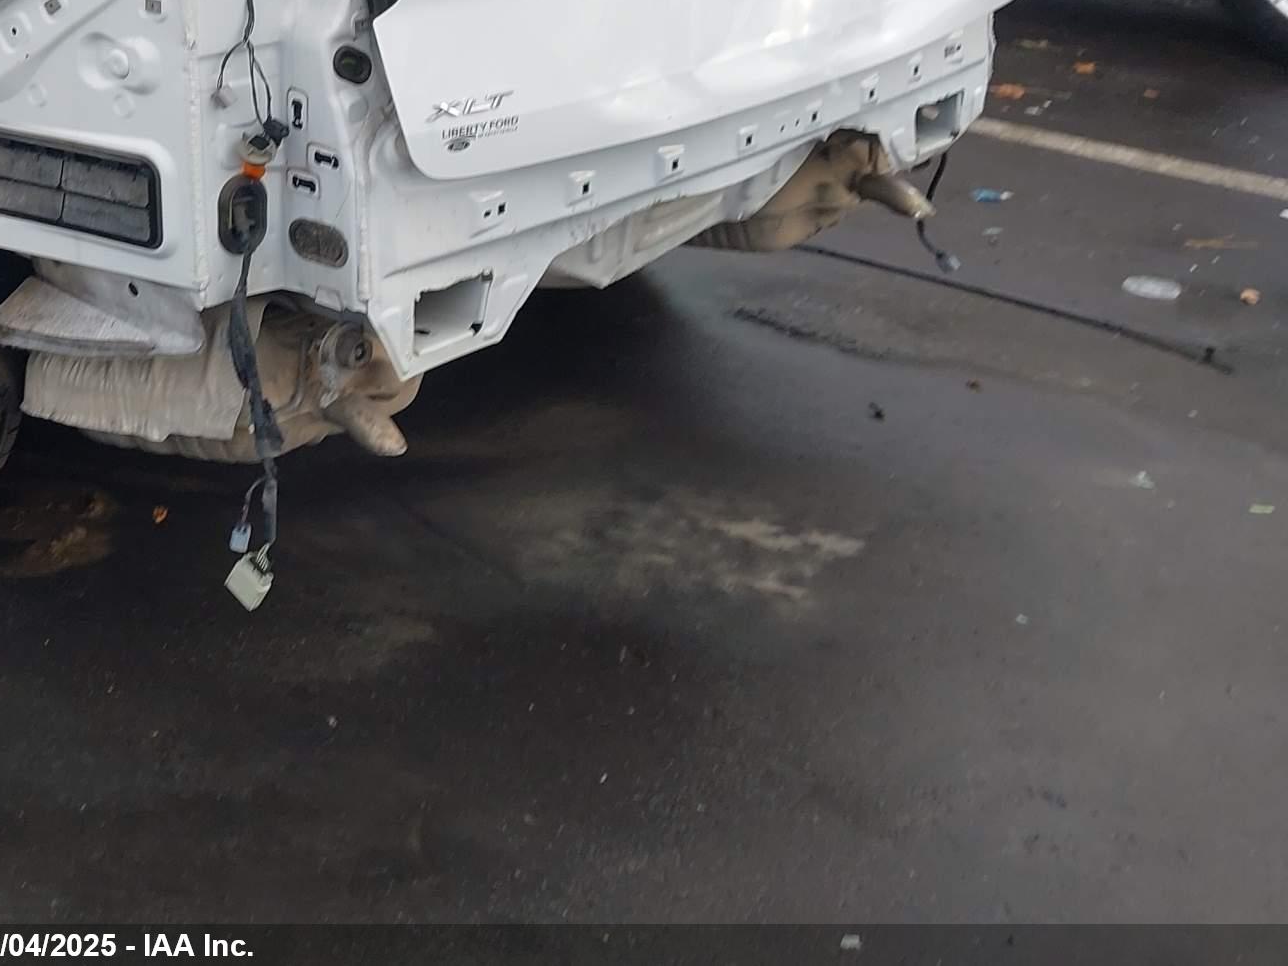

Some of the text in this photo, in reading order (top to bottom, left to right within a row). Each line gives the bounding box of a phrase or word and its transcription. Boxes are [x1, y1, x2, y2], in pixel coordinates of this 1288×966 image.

[426, 91, 514, 122] XLT
[441, 121, 488, 139] LIBERTY
[489, 116, 519, 130] FORD
